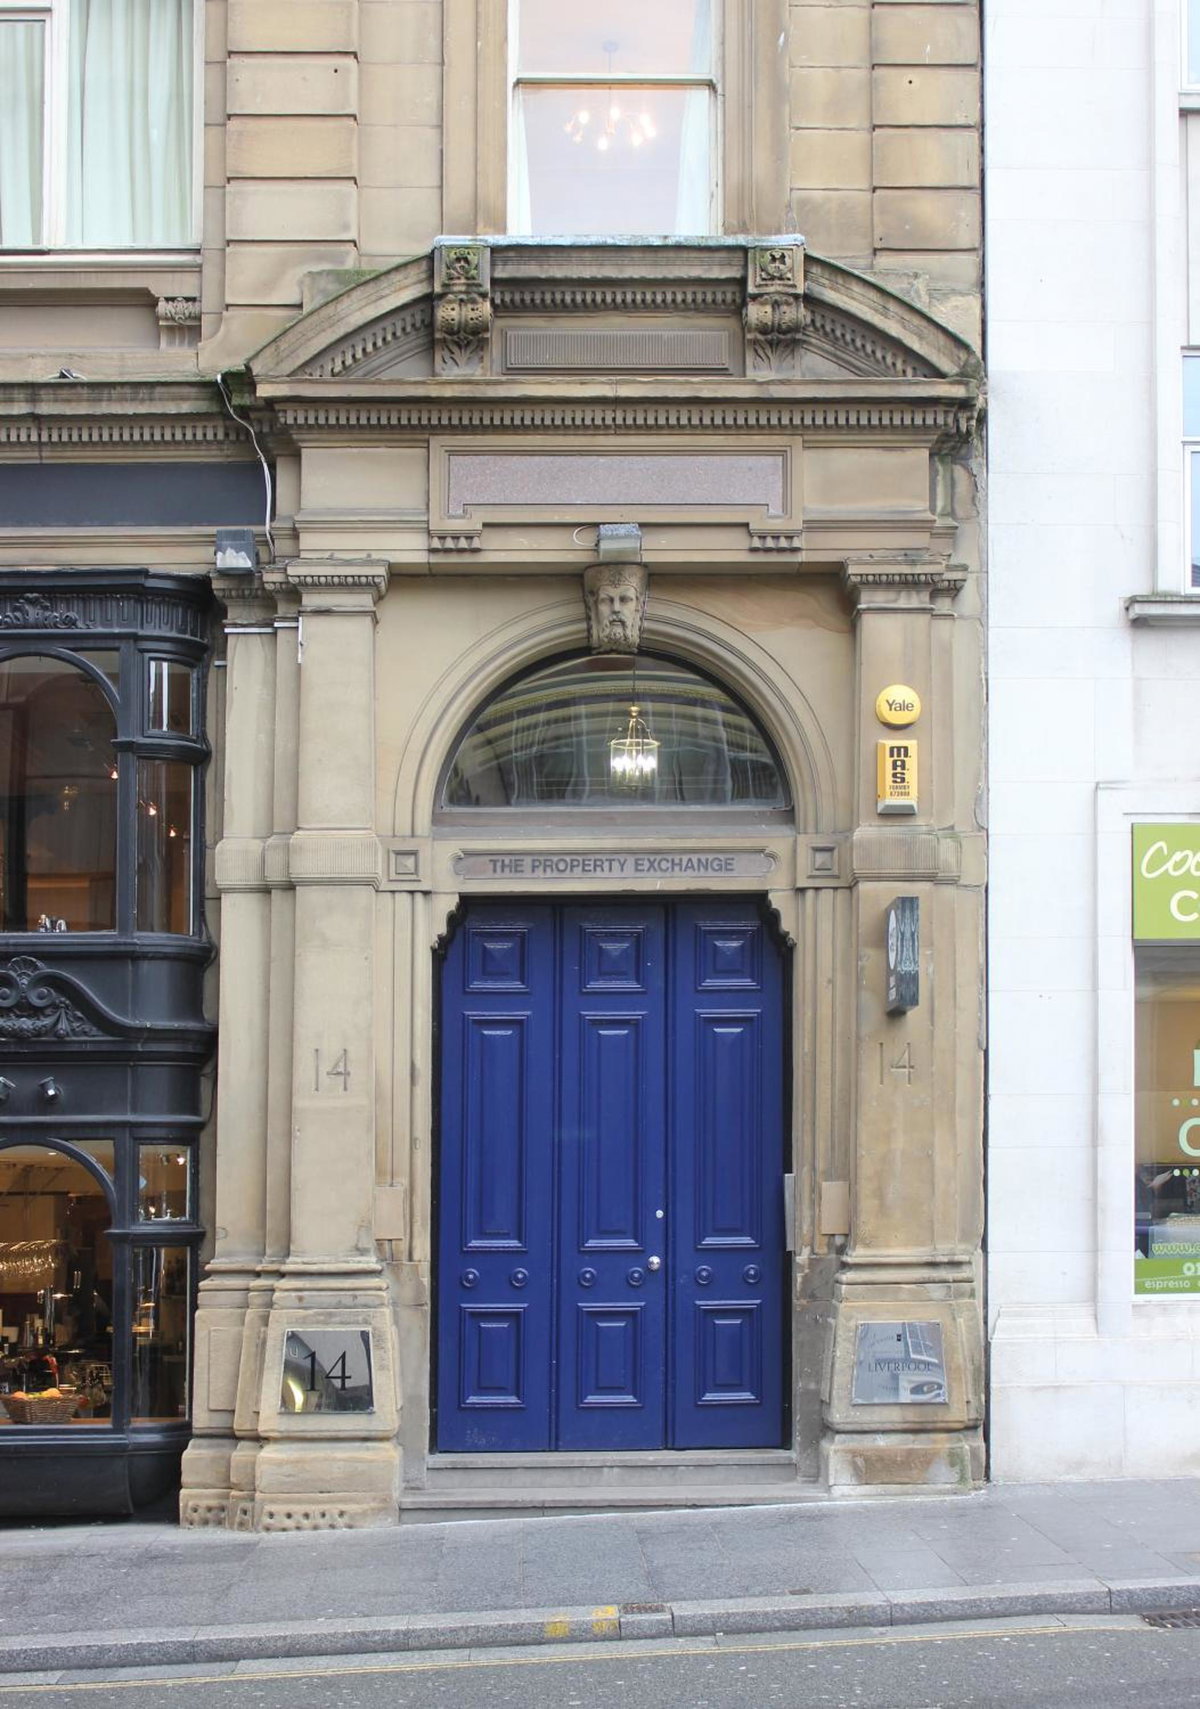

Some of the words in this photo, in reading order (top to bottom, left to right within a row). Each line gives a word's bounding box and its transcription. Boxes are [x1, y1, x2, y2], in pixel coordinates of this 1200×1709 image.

[885, 699, 915, 712] Yale
[489, 858, 524, 874] THE
[531, 857, 627, 874] PROPERTY
[634, 856, 735, 874] EXCHANGE
[1169, 889, 1200, 923] C
[314, 1048, 351, 1092] 14
[878, 1042, 915, 1086] 14
[1144, 1280, 1191, 1291] espresso
[303, 1350, 352, 1391] 14
[867, 1360, 932, 1374] LIVERPOOL
